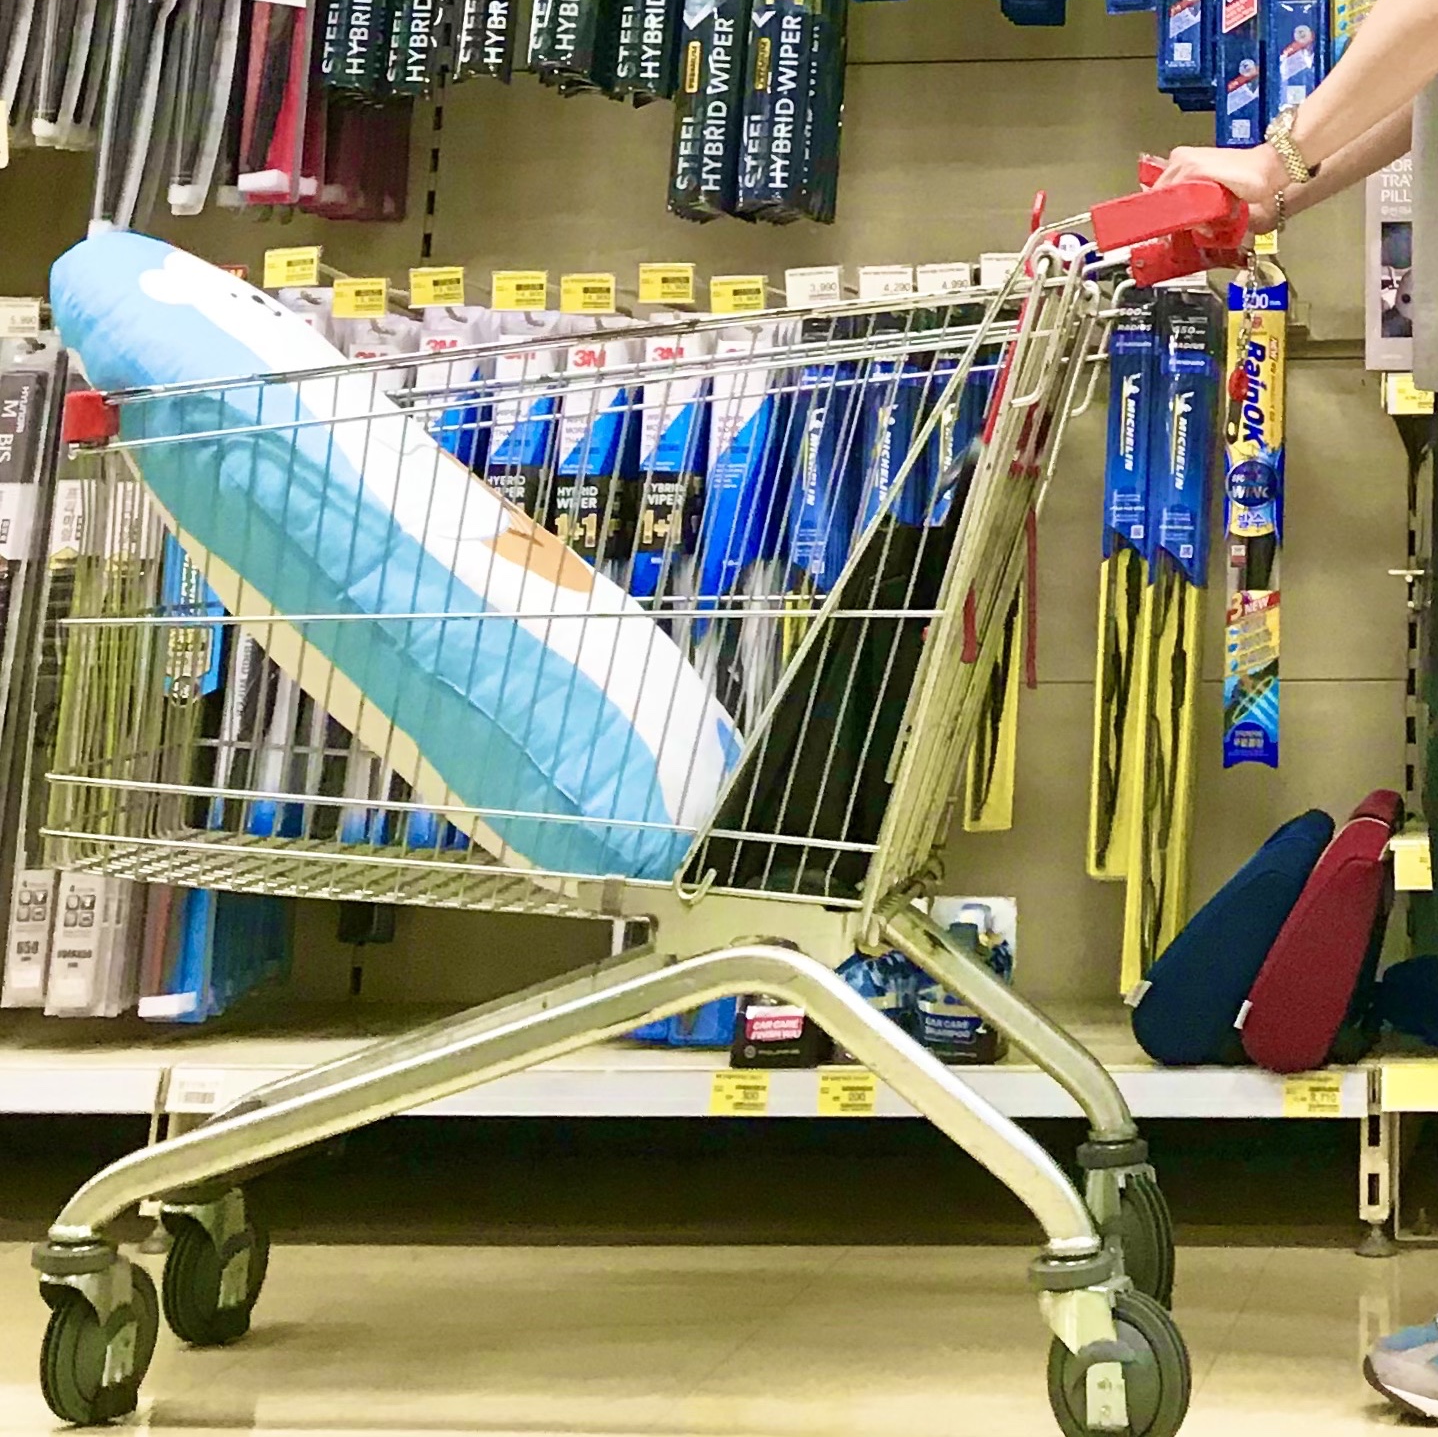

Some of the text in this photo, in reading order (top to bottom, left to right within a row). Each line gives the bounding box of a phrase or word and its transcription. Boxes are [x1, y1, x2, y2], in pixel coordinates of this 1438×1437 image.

[701, 16, 735, 192] HYBRID WIPER
[770, 14, 804, 190] HYBRID WIPER
[426, 338, 458, 353] 3M
[573, 349, 606, 368] 3M
[653, 346, 685, 361] 3M
[1240, 339, 1267, 456] RainOK
[1124, 398, 1137, 472] MICHELIN
[1174, 416, 1188, 491] MICHELIN
[555, 513, 597, 548] 1+1
[642, 509, 683, 545] 1+1
[1230, 591, 1272, 621] 3 NEW
